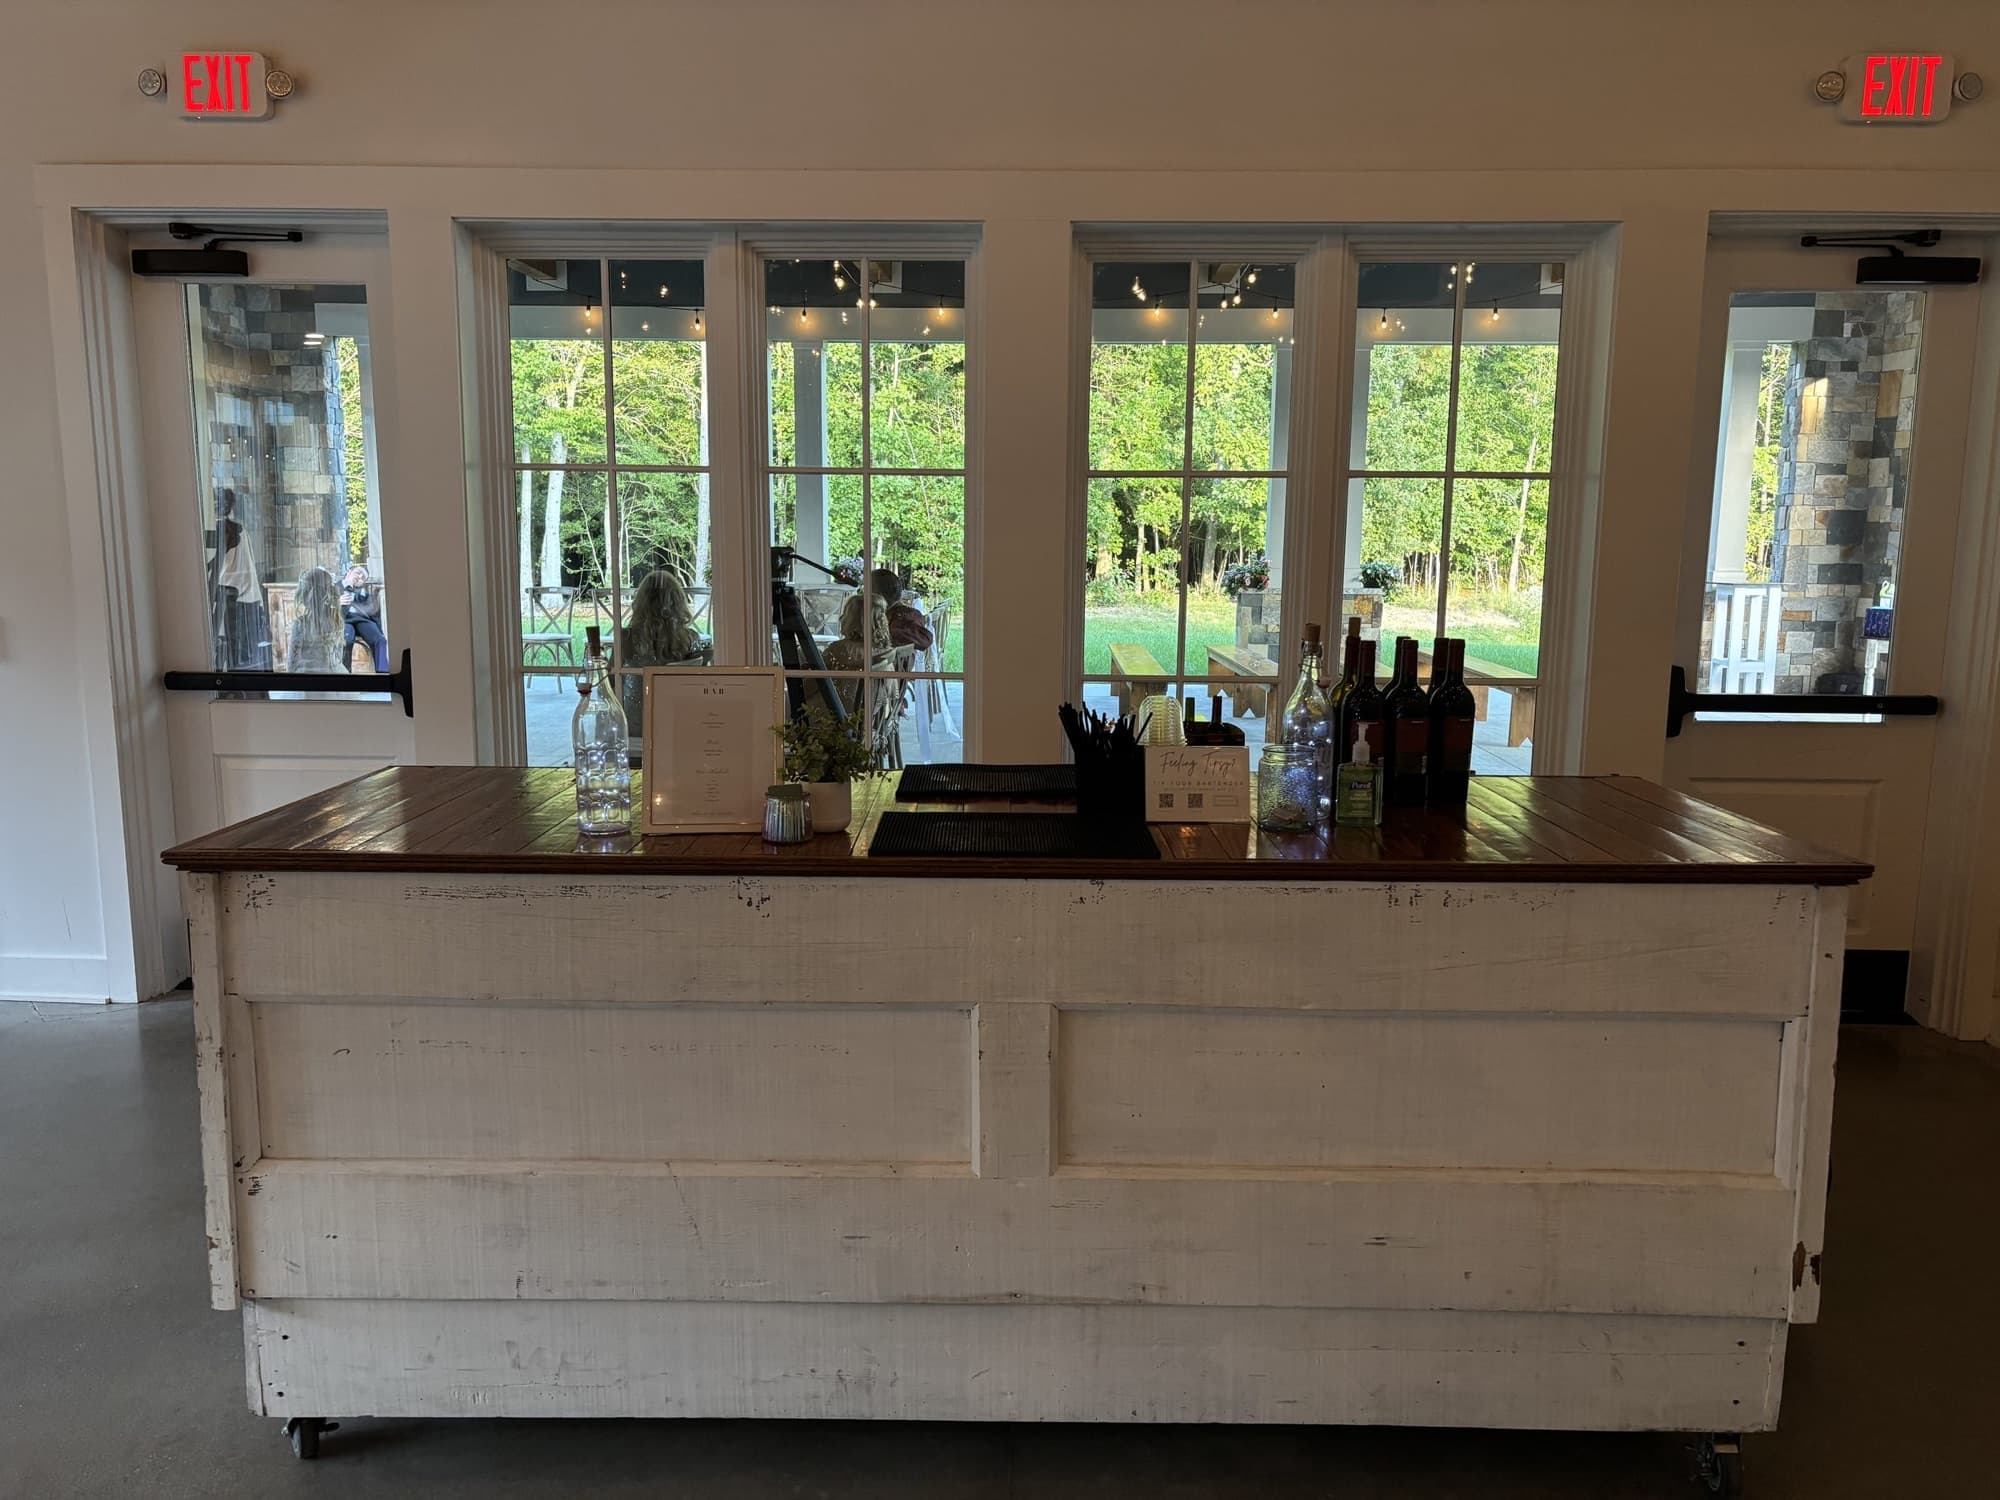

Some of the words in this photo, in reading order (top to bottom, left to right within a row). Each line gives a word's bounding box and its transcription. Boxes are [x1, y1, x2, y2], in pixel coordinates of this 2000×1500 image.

[182, 52, 253, 113] EXIT
[1861, 55, 1943, 117] EXIT
[1160, 751, 1198, 776] Feeling
[1200, 750, 1236, 778] Tipsy?
